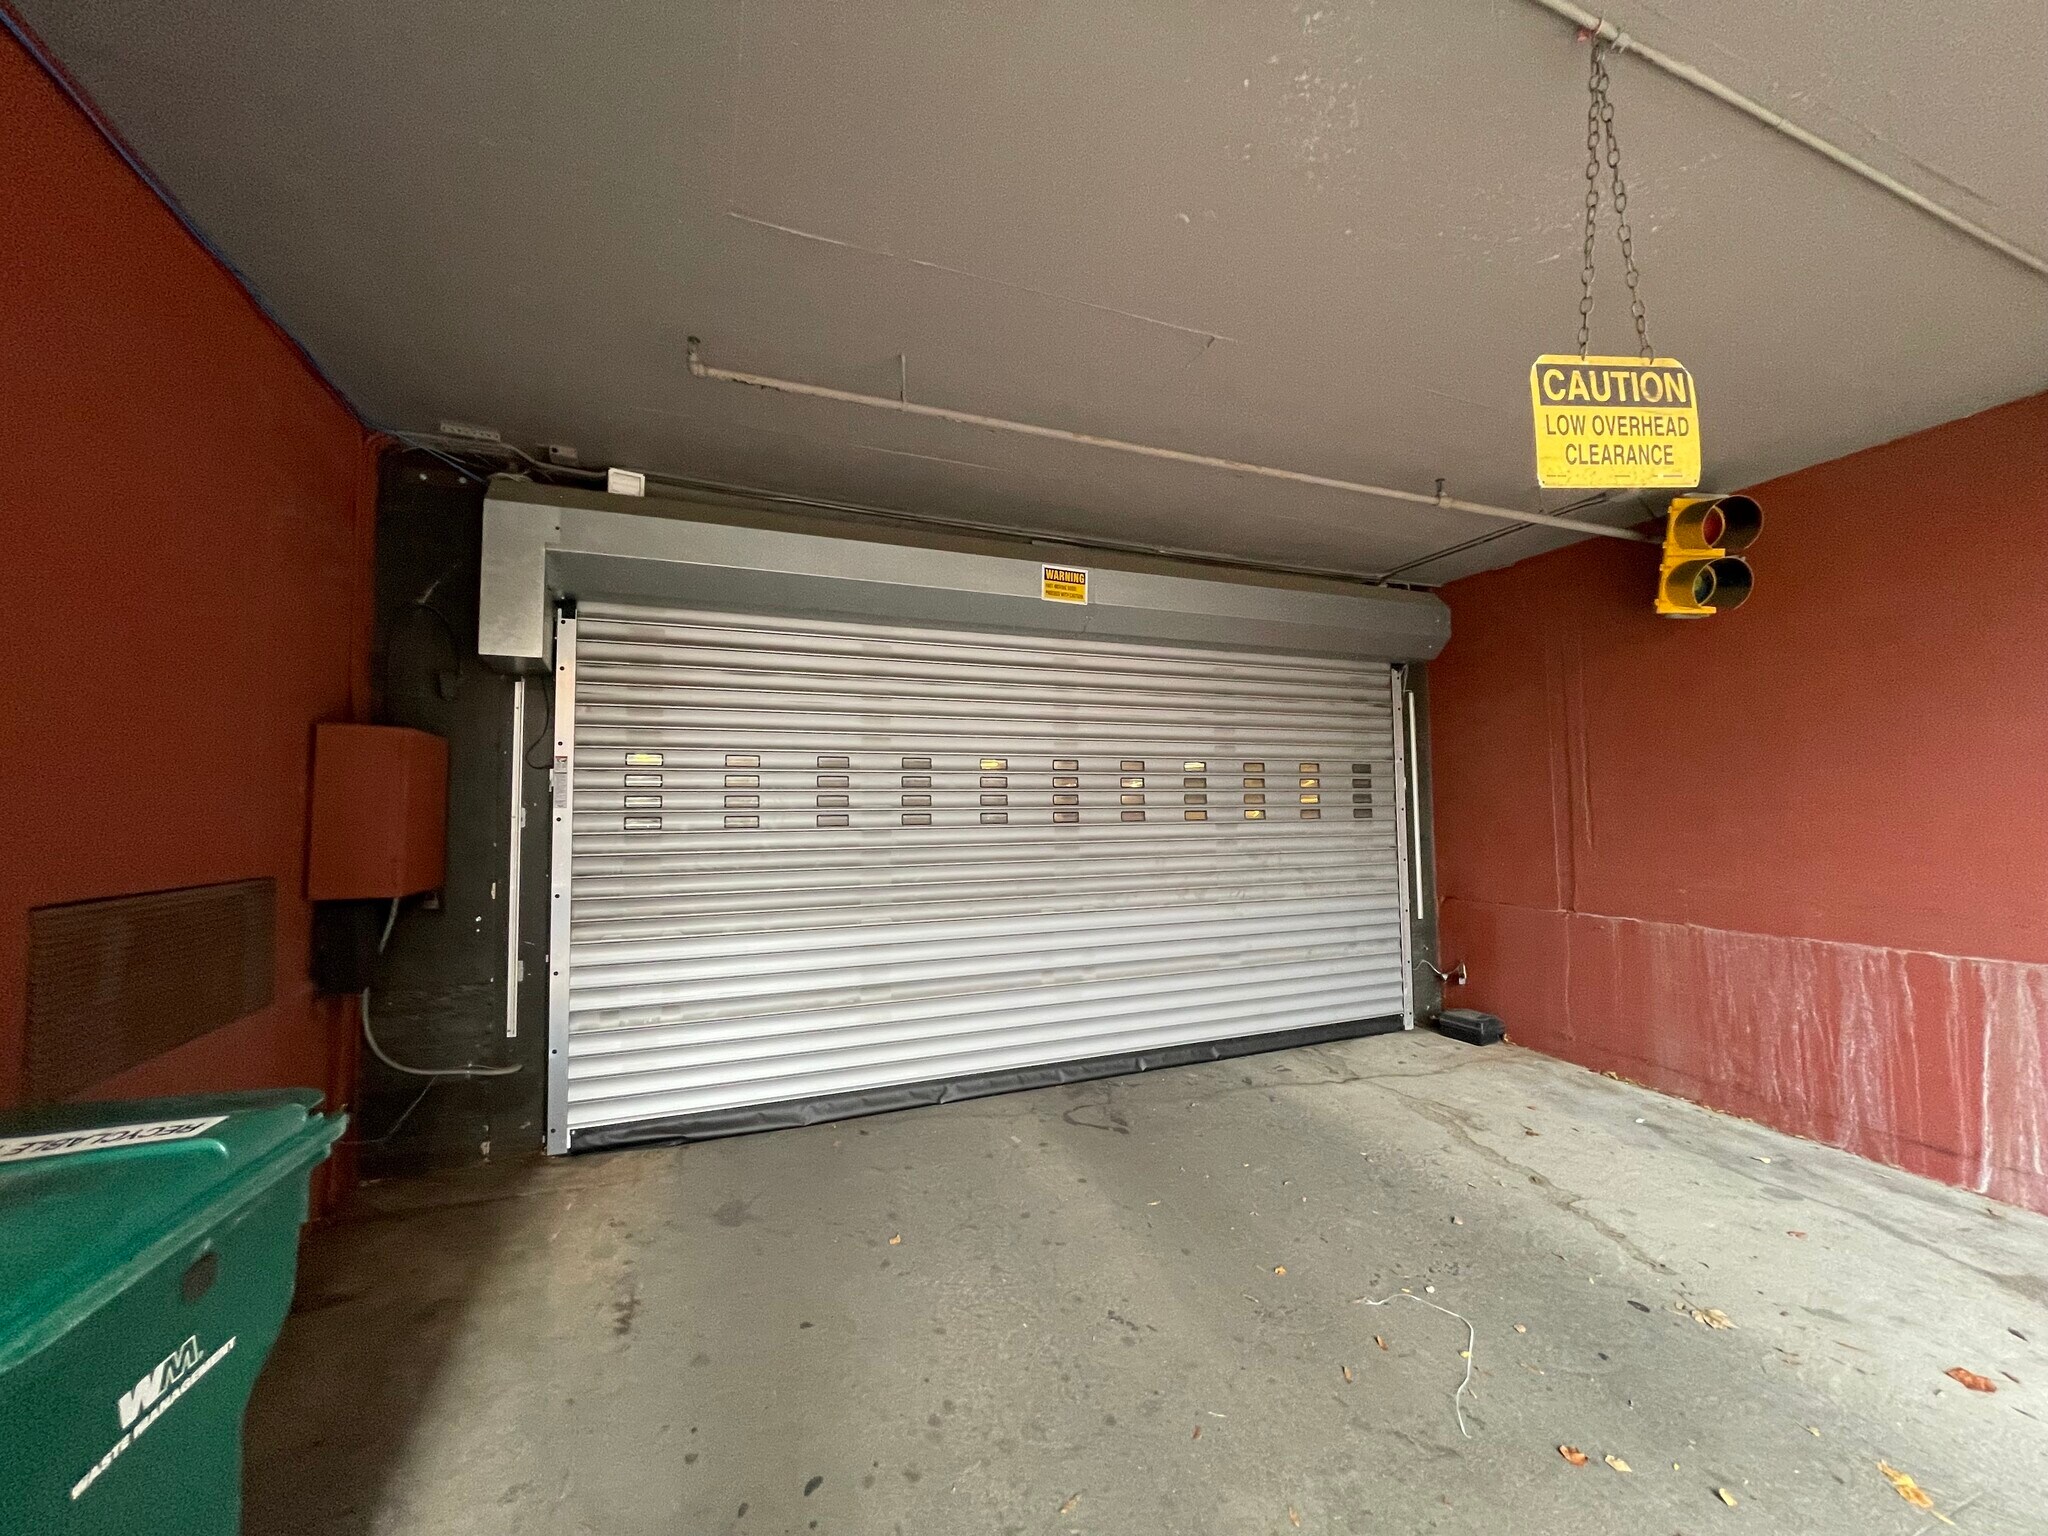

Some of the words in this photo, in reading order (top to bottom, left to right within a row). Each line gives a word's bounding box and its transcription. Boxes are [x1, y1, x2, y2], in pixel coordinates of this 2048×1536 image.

[1543, 369, 1687, 403] CAUTION
[1546, 414, 1586, 435] LOW
[1592, 415, 1689, 436] OVERHEAD
[1565, 443, 1674, 465] CLEARANCE
[1046, 569, 1085, 583] WARNING
[0, 1122, 206, 1157] RECYCLABLE
